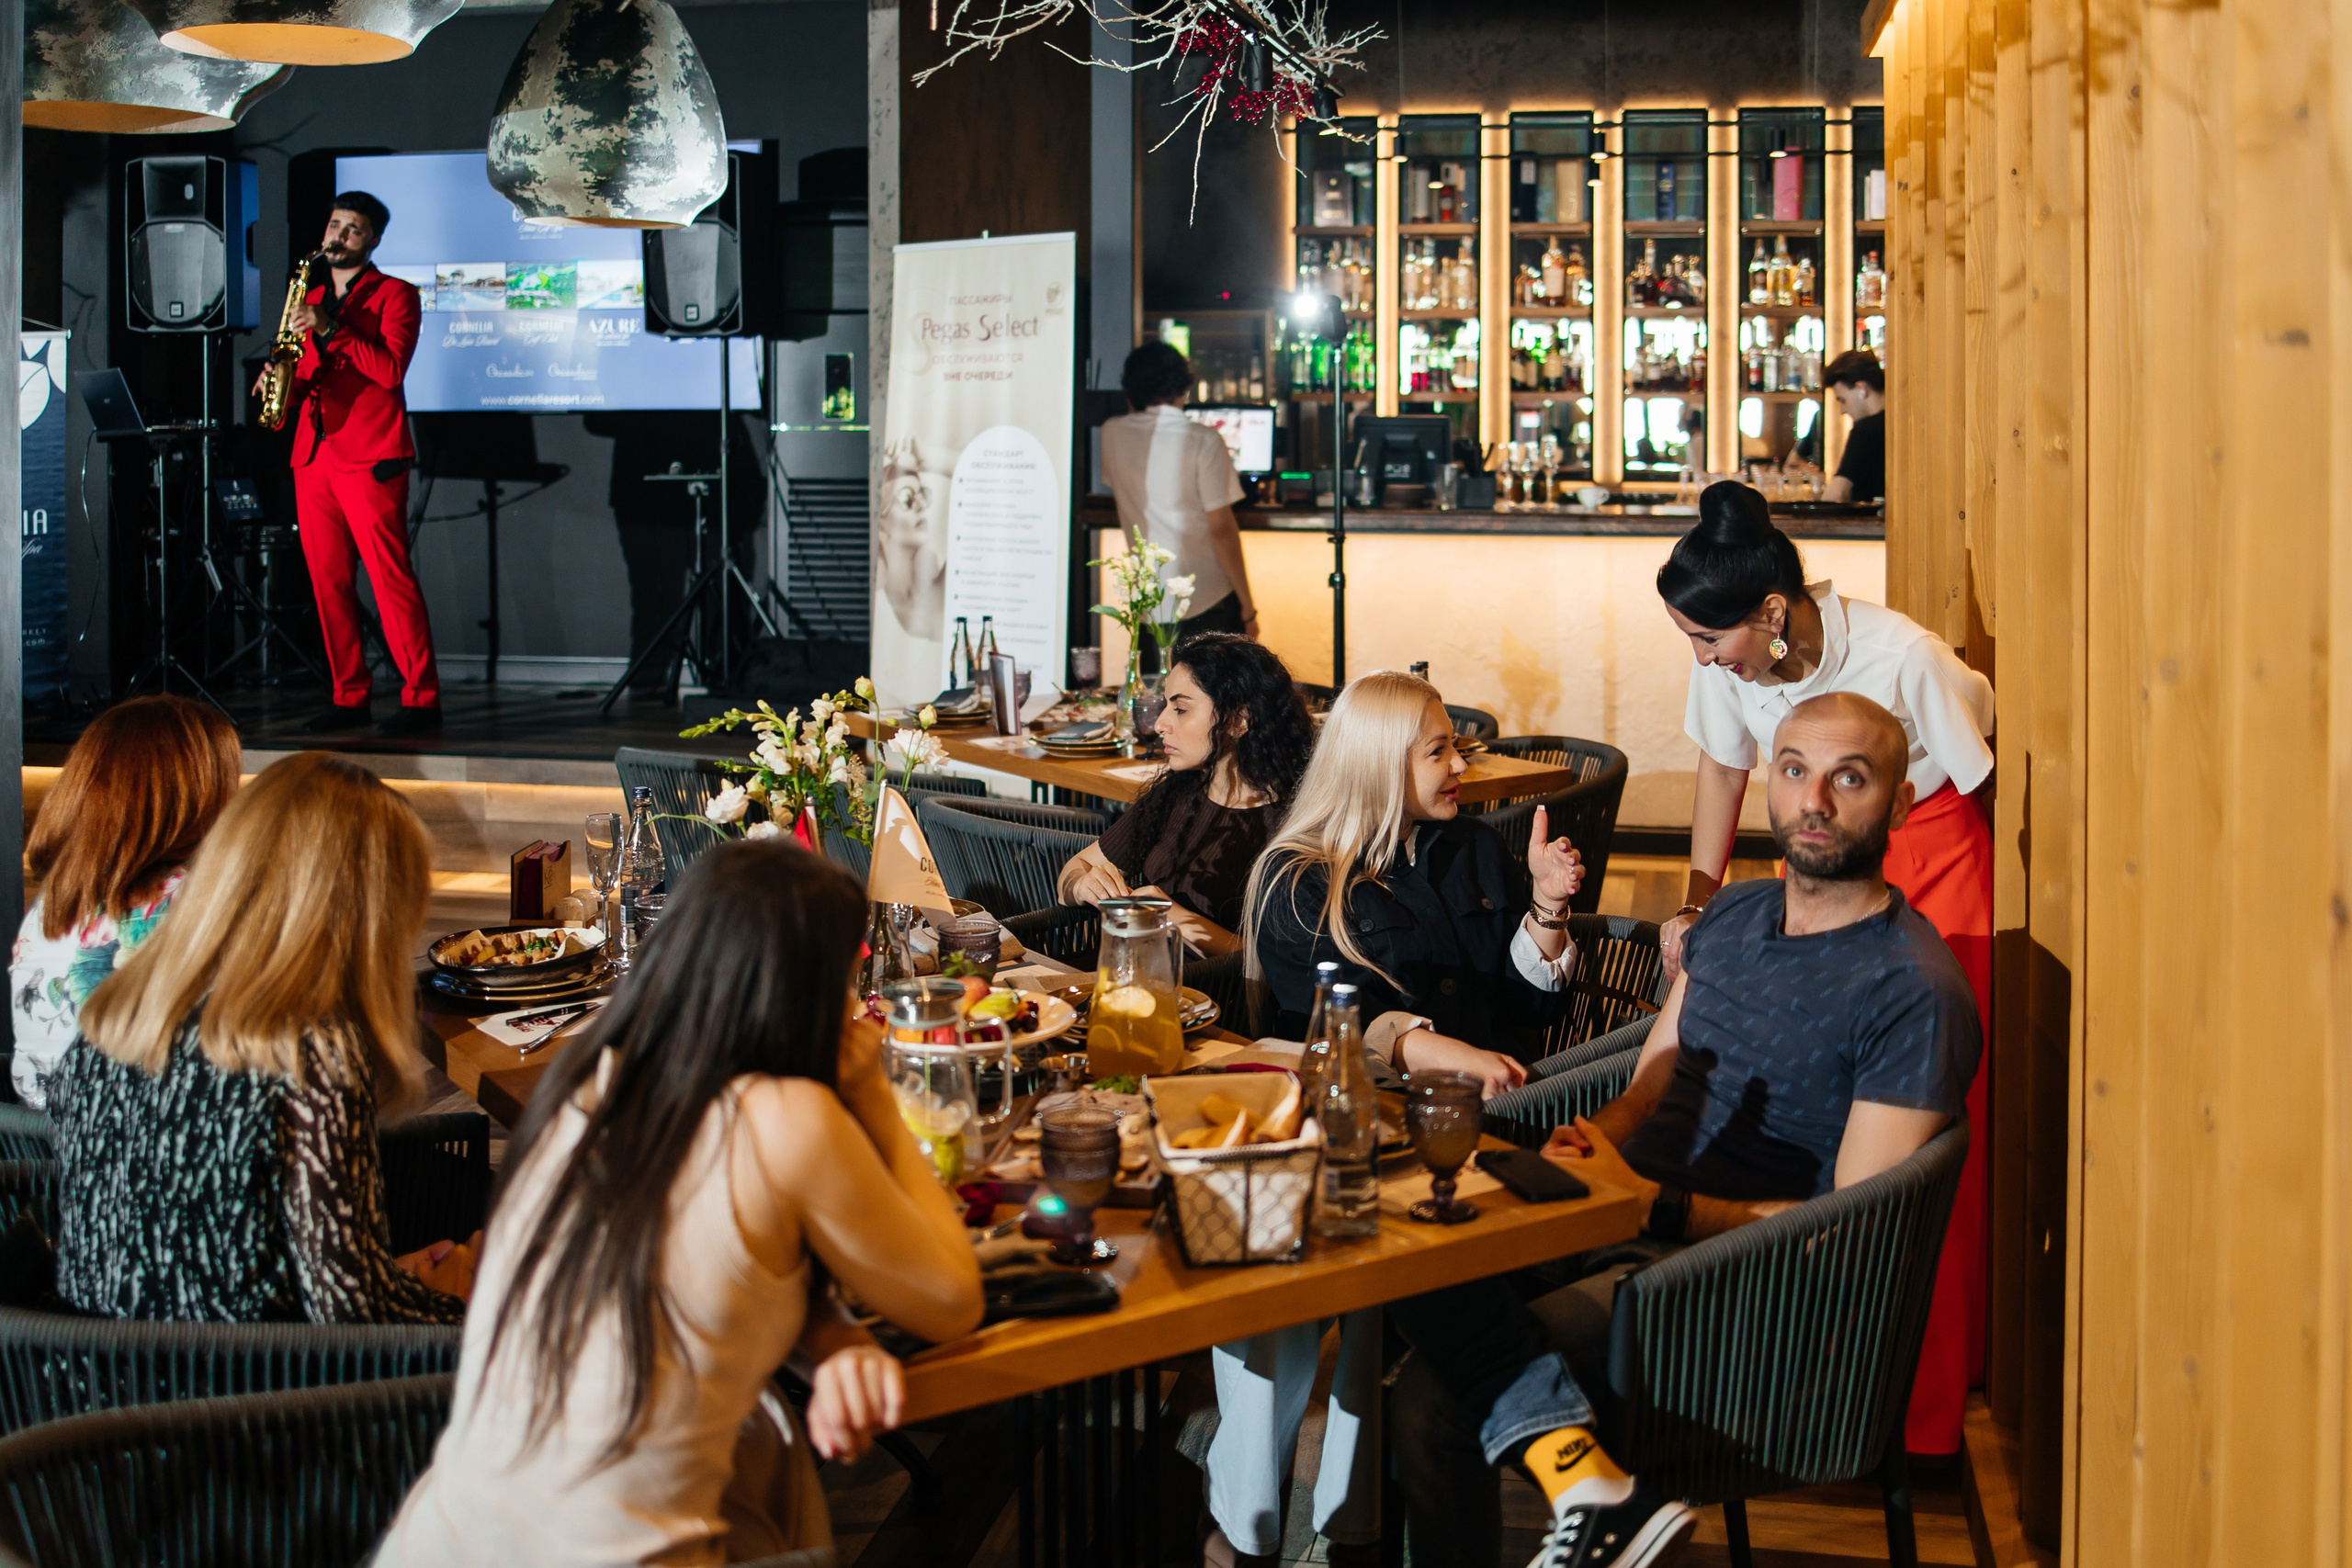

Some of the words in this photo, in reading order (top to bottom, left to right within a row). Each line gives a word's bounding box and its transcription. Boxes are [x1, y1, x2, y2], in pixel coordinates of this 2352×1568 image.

[948, 294, 1013, 305] ПАССАЖИРЫ
[590, 318, 640, 334] AZURE
[922, 317, 971, 344] Pegas
[978, 312, 1038, 342] Select
[932, 352, 1023, 365] ОБСЛУЖИВАЮТСЯ
[964, 370, 1013, 382] ОЧЕРЕДИ
[481, 392, 605, 406] www.corneliaresort.com
[983, 449, 1024, 457] СТАНДАРТ
[1556, 1438, 1588, 1461] NIKE
